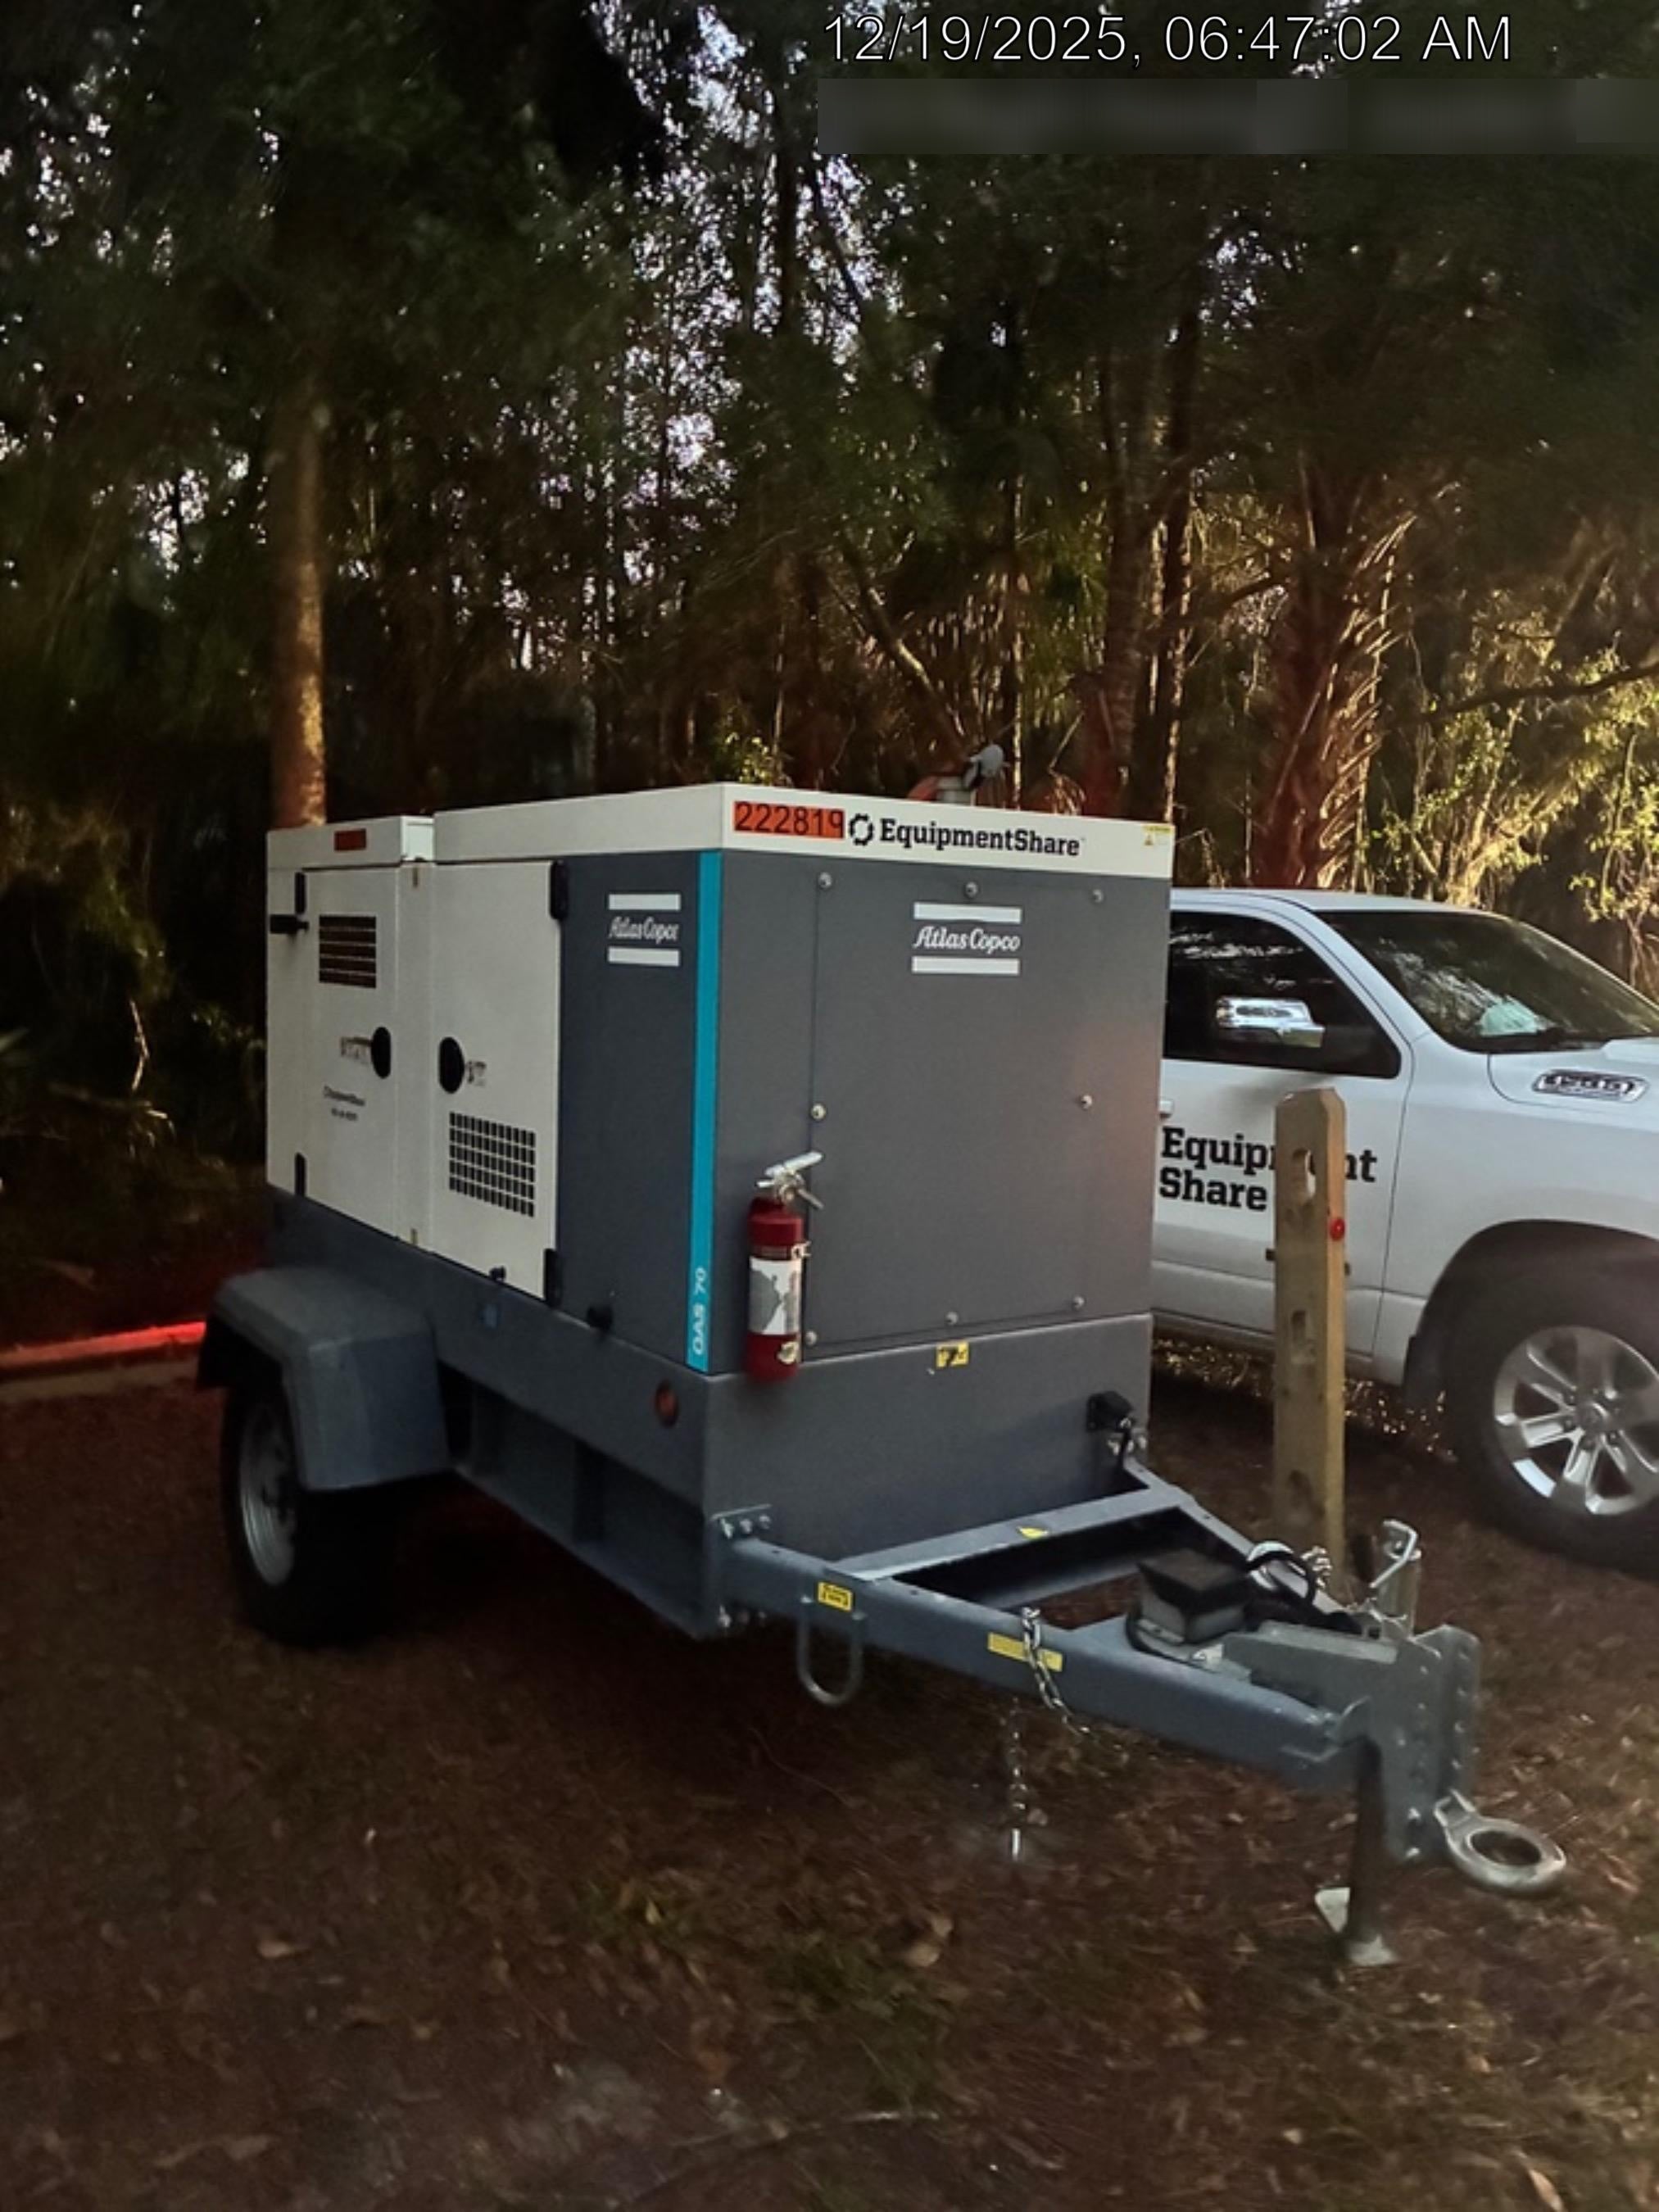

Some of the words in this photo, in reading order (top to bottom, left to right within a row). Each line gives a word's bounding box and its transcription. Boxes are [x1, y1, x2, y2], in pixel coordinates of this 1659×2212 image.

[735, 802, 843, 836] 222819
[881, 818, 1081, 857] EquipmentShare
[1162, 1126, 1377, 1182] Equipnt
[1159, 1167, 1267, 1211] Share
[694, 1266, 707, 1295] 70
